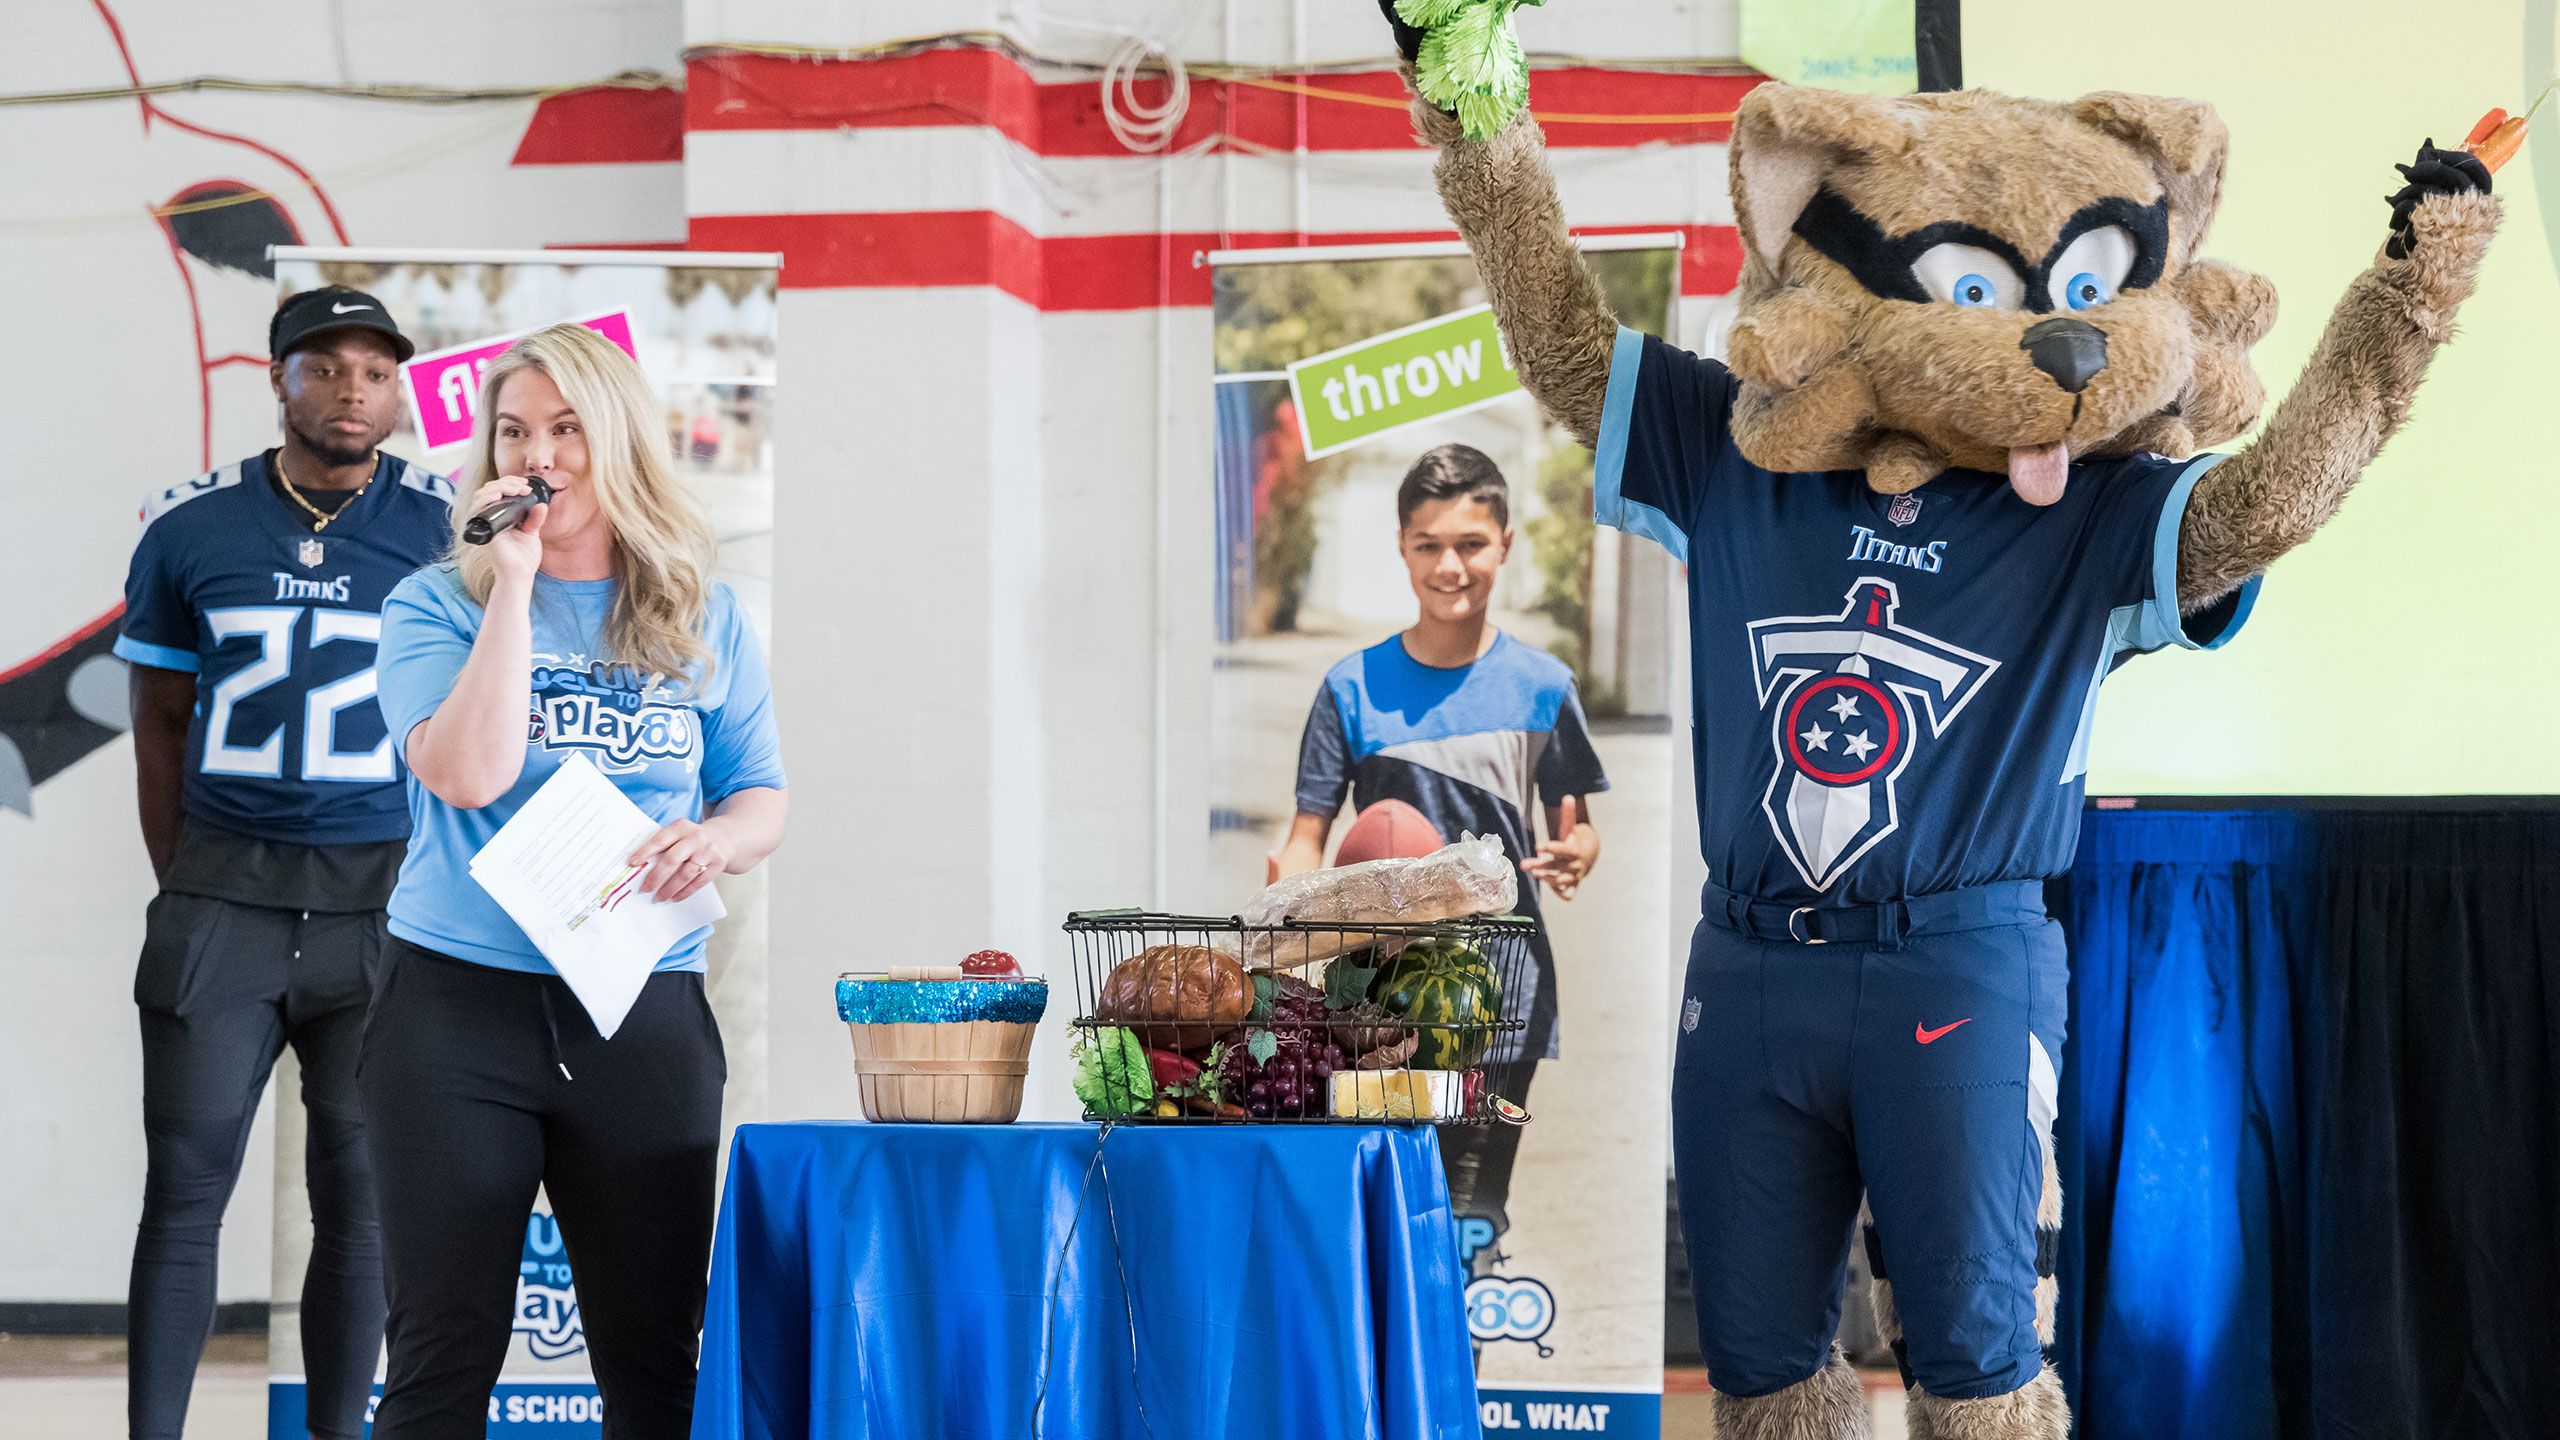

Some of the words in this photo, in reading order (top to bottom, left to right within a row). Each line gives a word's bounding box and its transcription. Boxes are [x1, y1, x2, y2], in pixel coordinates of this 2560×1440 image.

[1321, 338, 1483, 423] throw
[1892, 506, 1916, 521] NFL
[199, 605, 398, 783] 22
[614, 691, 640, 709] TO
[528, 1214, 564, 1257] U
[1453, 1217, 1495, 1261] P
[542, 1263, 572, 1284] TO
[523, 1294, 578, 1335] ay
[1470, 1287, 1544, 1331] 60
[505, 1395, 603, 1424] SCHOO
[1479, 1400, 1521, 1430] OL
[1525, 1402, 1611, 1432] WHAT
